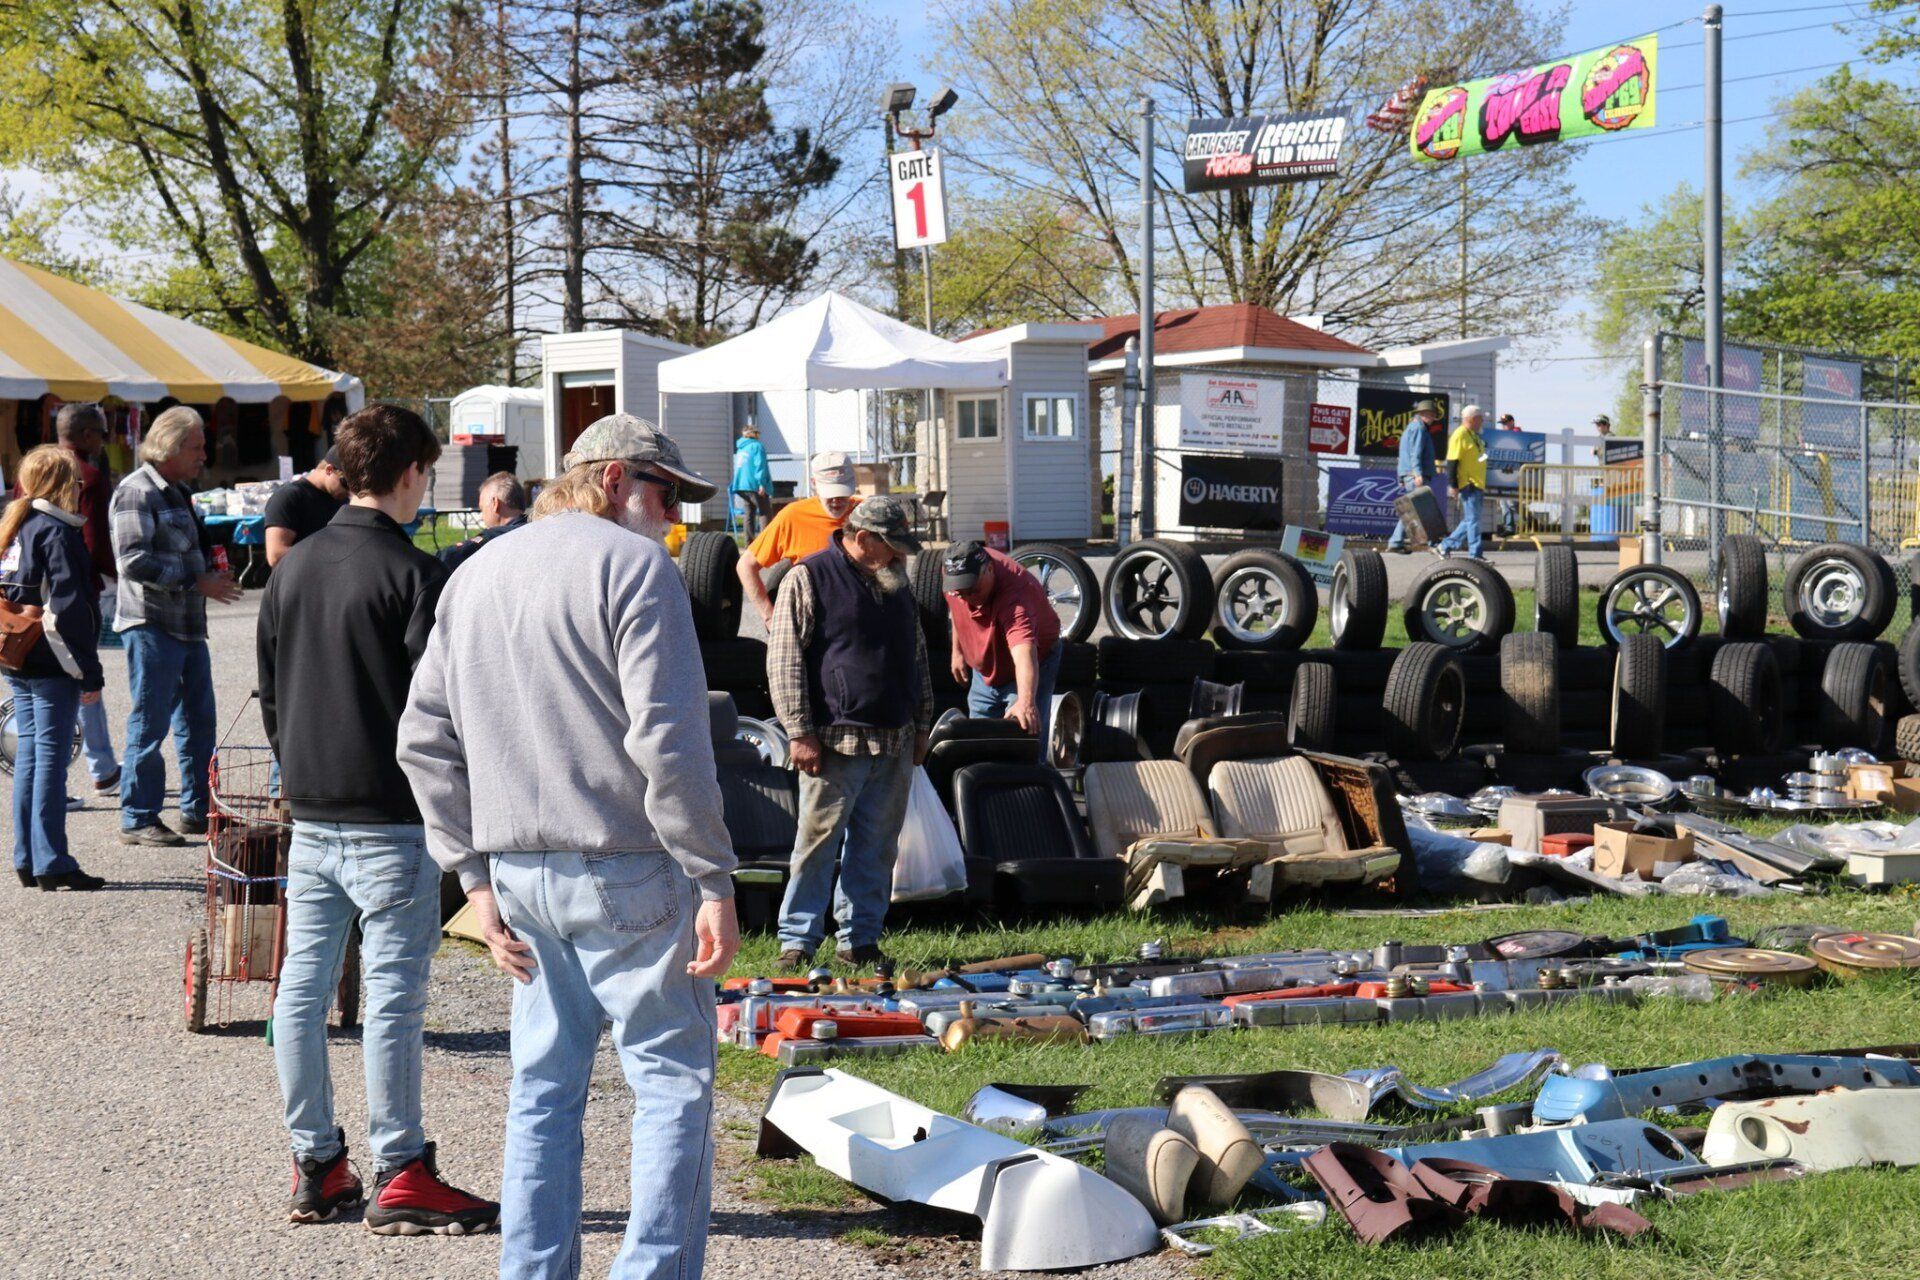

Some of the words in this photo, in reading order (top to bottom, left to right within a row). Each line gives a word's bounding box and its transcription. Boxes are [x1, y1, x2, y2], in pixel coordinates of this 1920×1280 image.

[1260, 117, 1345, 149] REGISTER
[1186, 131, 1250, 159] CARLISLE
[1257, 147, 1269, 165] TO
[1273, 145, 1293, 164] BID
[1296, 142, 1341, 162] TODAY!
[898, 156, 933, 180] GATE
[1258, 167, 1288, 177] CARLISLE
[1290, 165, 1307, 175] EXPO
[1310, 163, 1336, 174] CENTER
[906, 181, 928, 238] 1
[1313, 407, 1330, 416] THIS
[1331, 409, 1349, 418] GATE
[1208, 483, 1279, 504] HAGERTY
